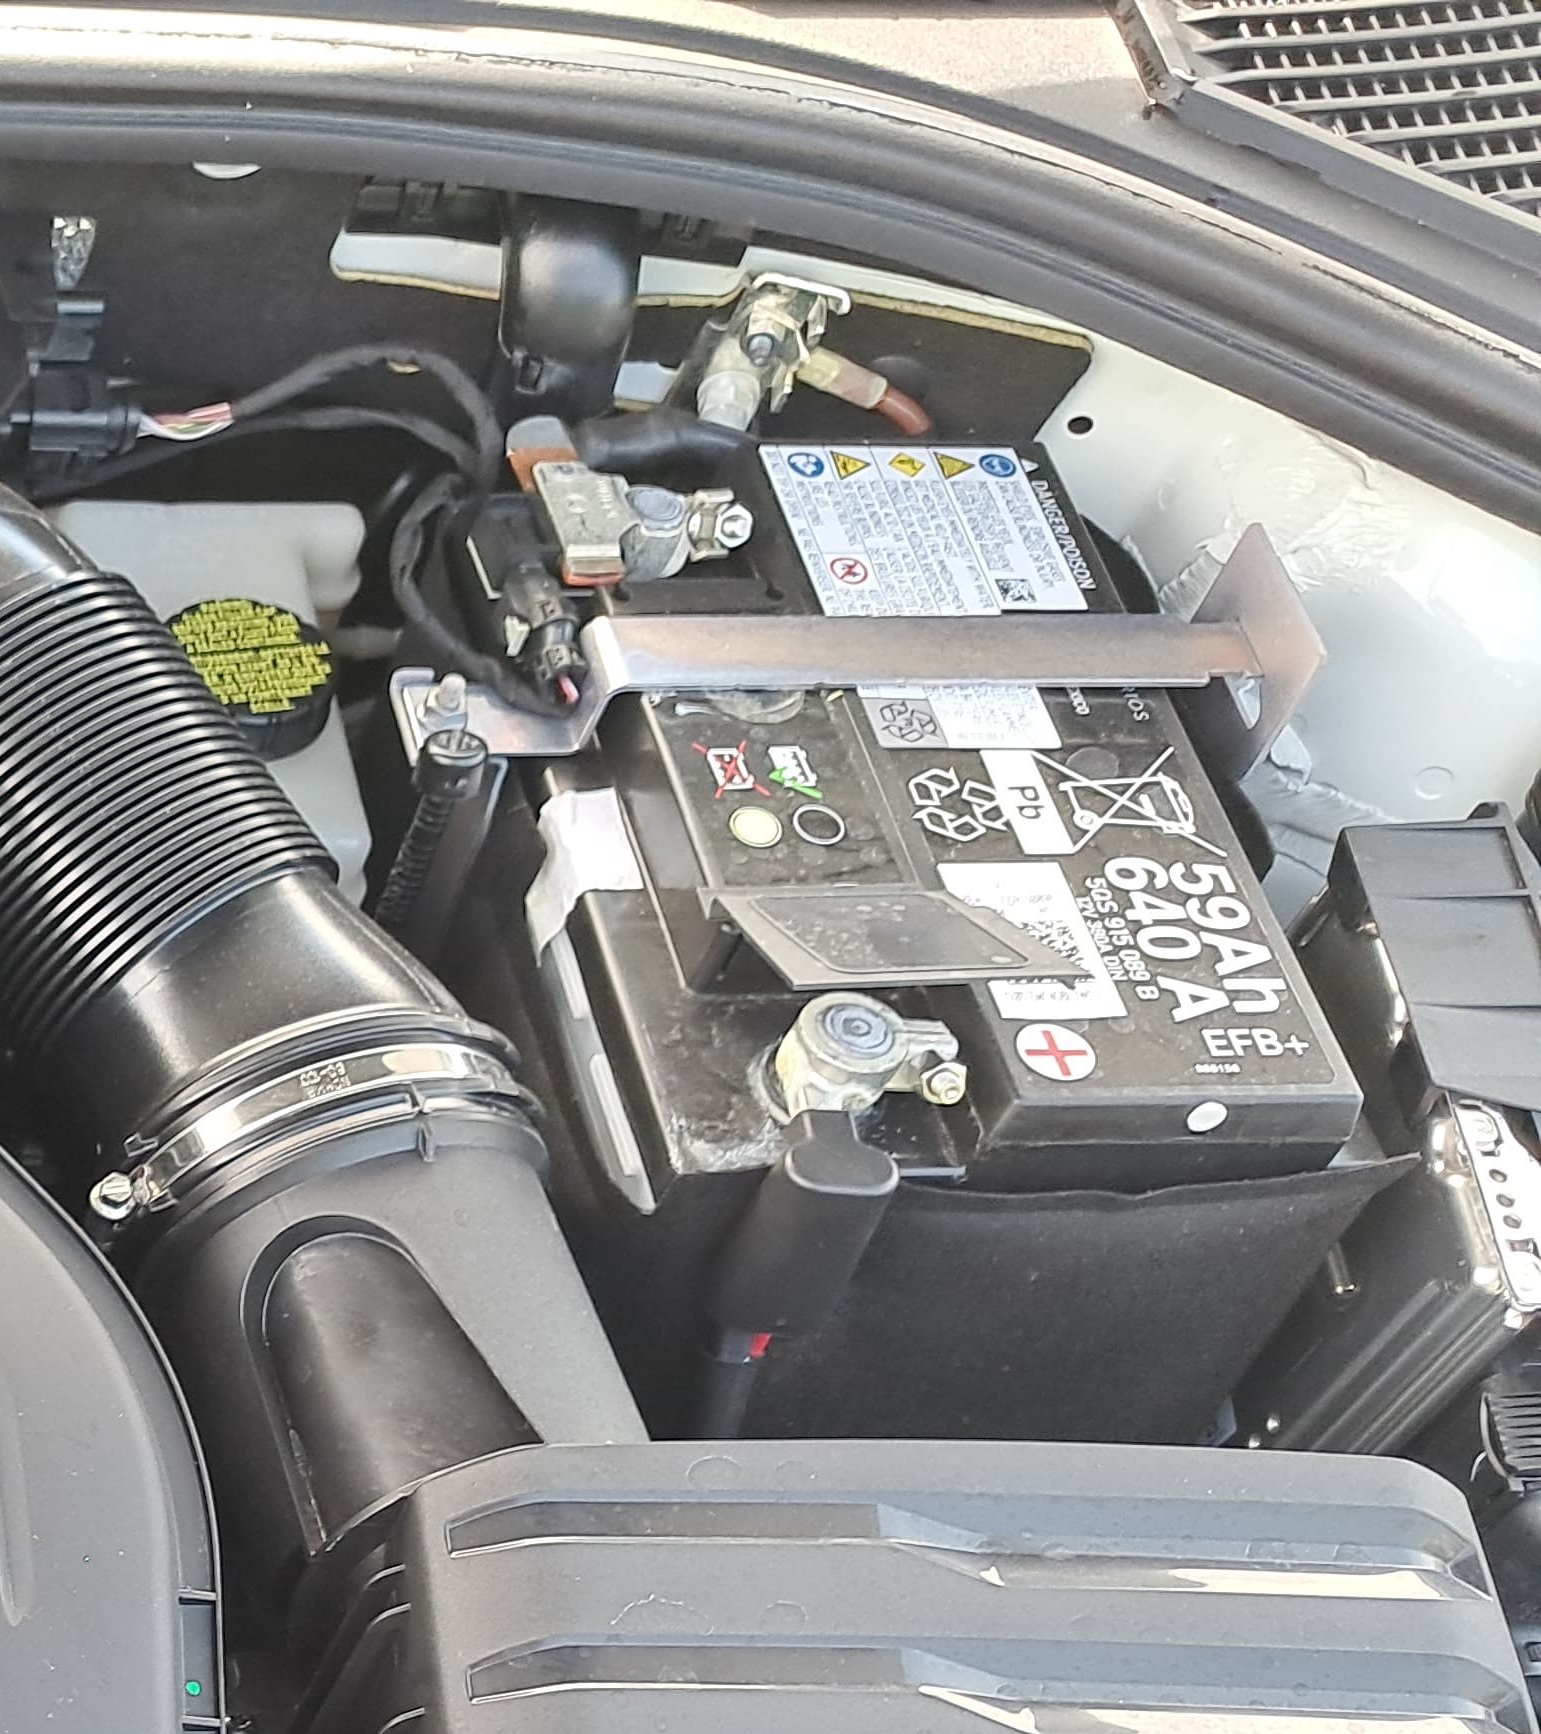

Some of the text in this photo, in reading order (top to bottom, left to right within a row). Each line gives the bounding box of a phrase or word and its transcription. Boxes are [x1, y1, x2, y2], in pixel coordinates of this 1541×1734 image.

[1031, 480, 1096, 590] DANGER/POISON
[1008, 786, 1044, 819] Pb
[1104, 917, 1135, 947] 915
[1104, 856, 1231, 1023] 640 A
[1169, 861, 1288, 1014] 59Ah
[1119, 950, 1151, 982] 089
[1200, 1028, 1310, 1057] EFB+
